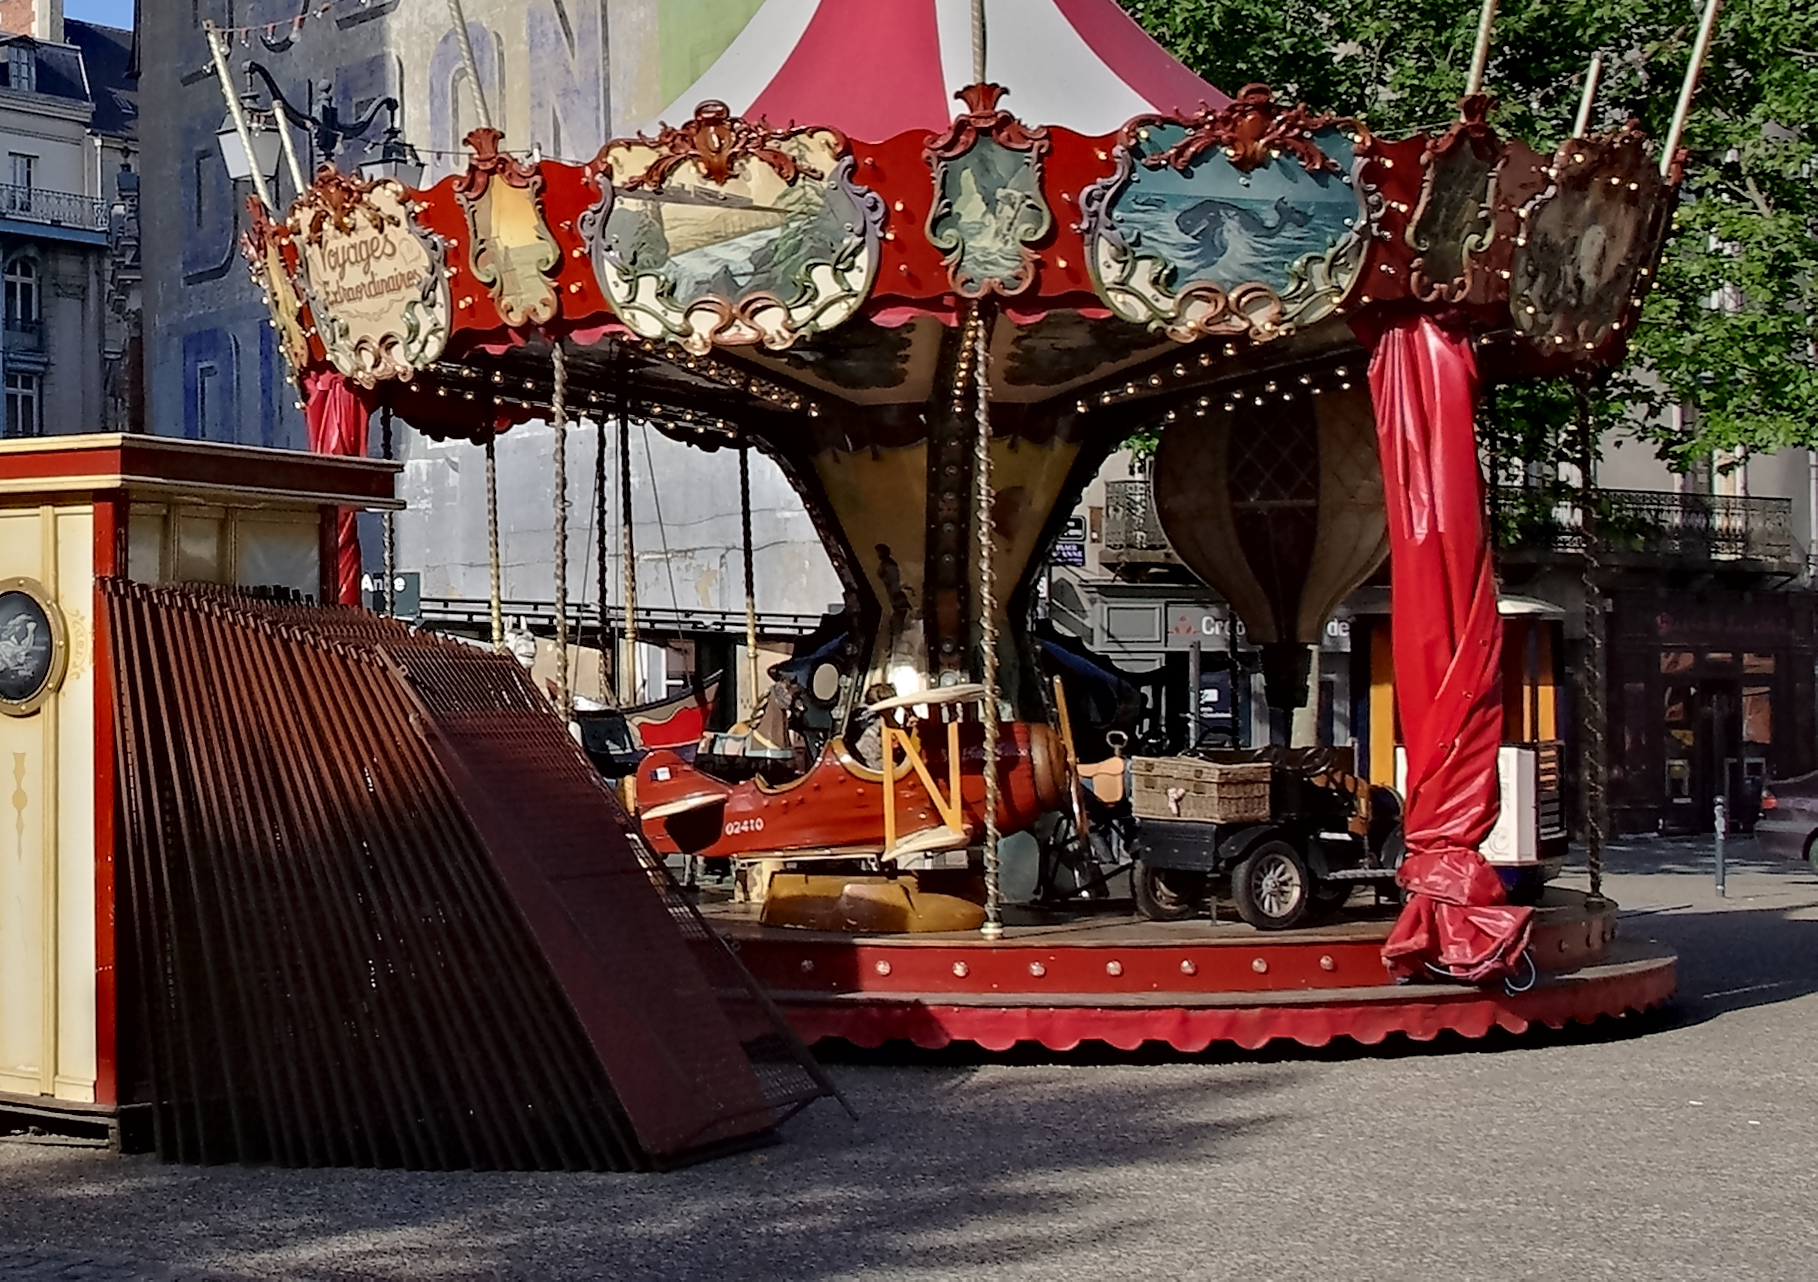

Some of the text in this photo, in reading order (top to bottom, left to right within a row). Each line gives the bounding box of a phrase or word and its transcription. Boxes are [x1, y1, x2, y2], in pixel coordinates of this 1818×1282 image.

[320, 233, 397, 281] Voyages
[322, 267, 423, 306] Extraordinaires
[361, 573, 406, 592] Ane
[1326, 619, 1351, 637] de
[725, 818, 764, 835] 02410
